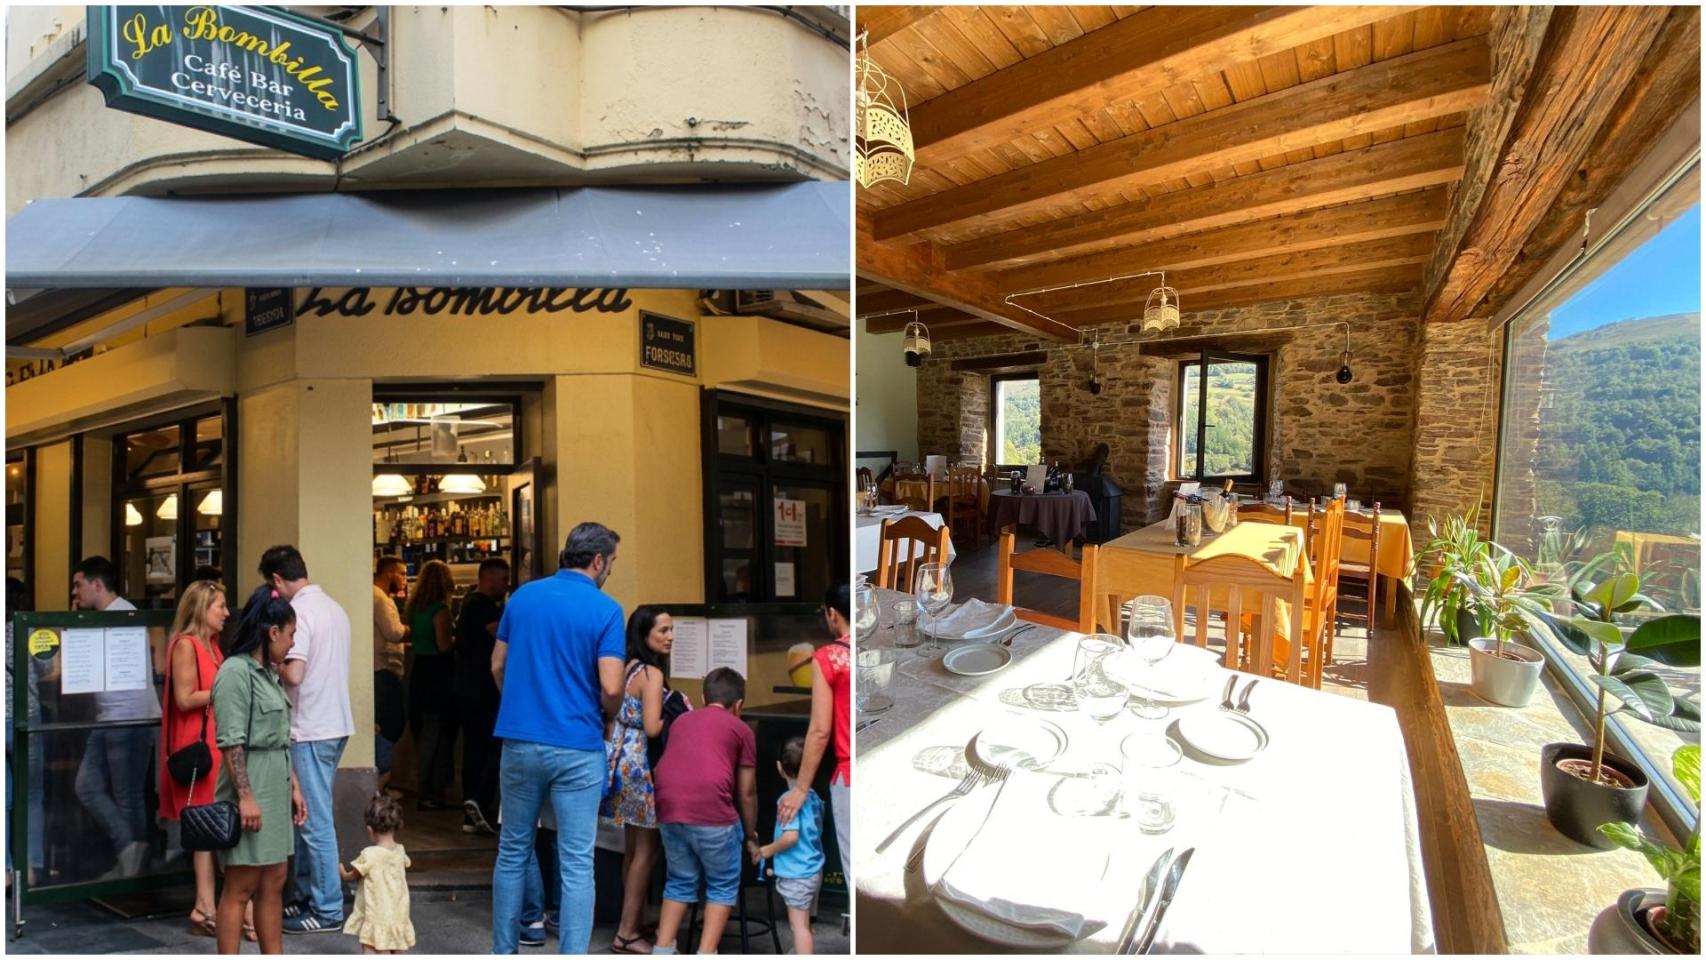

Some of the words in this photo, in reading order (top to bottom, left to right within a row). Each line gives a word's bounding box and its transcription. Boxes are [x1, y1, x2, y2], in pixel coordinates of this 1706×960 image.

[123, 13, 172, 60] La
[183, 6, 338, 112] Bombilla
[184, 54, 242, 84] Café
[250, 70, 294, 98] Bar
